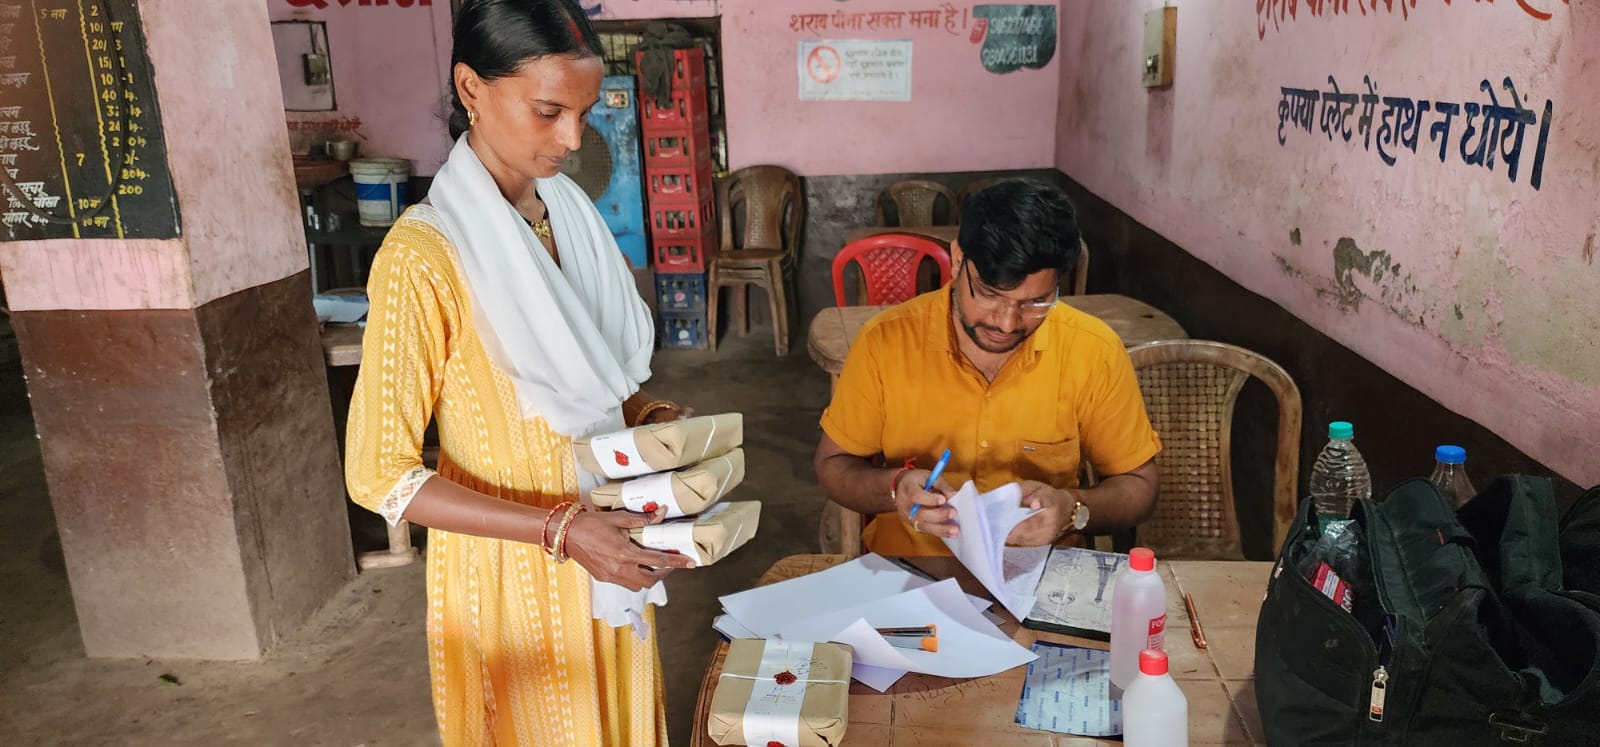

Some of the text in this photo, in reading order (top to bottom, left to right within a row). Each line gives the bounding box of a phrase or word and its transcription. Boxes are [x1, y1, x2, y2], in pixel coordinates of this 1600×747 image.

[908, 9, 940, 29] मना
[1278, 86, 1319, 146] कृपया
[1320, 74, 1359, 141] प्लेट
[1358, 74, 1379, 151] में
[1376, 96, 1430, 167] हाथ
[1430, 101, 1460, 163] न
